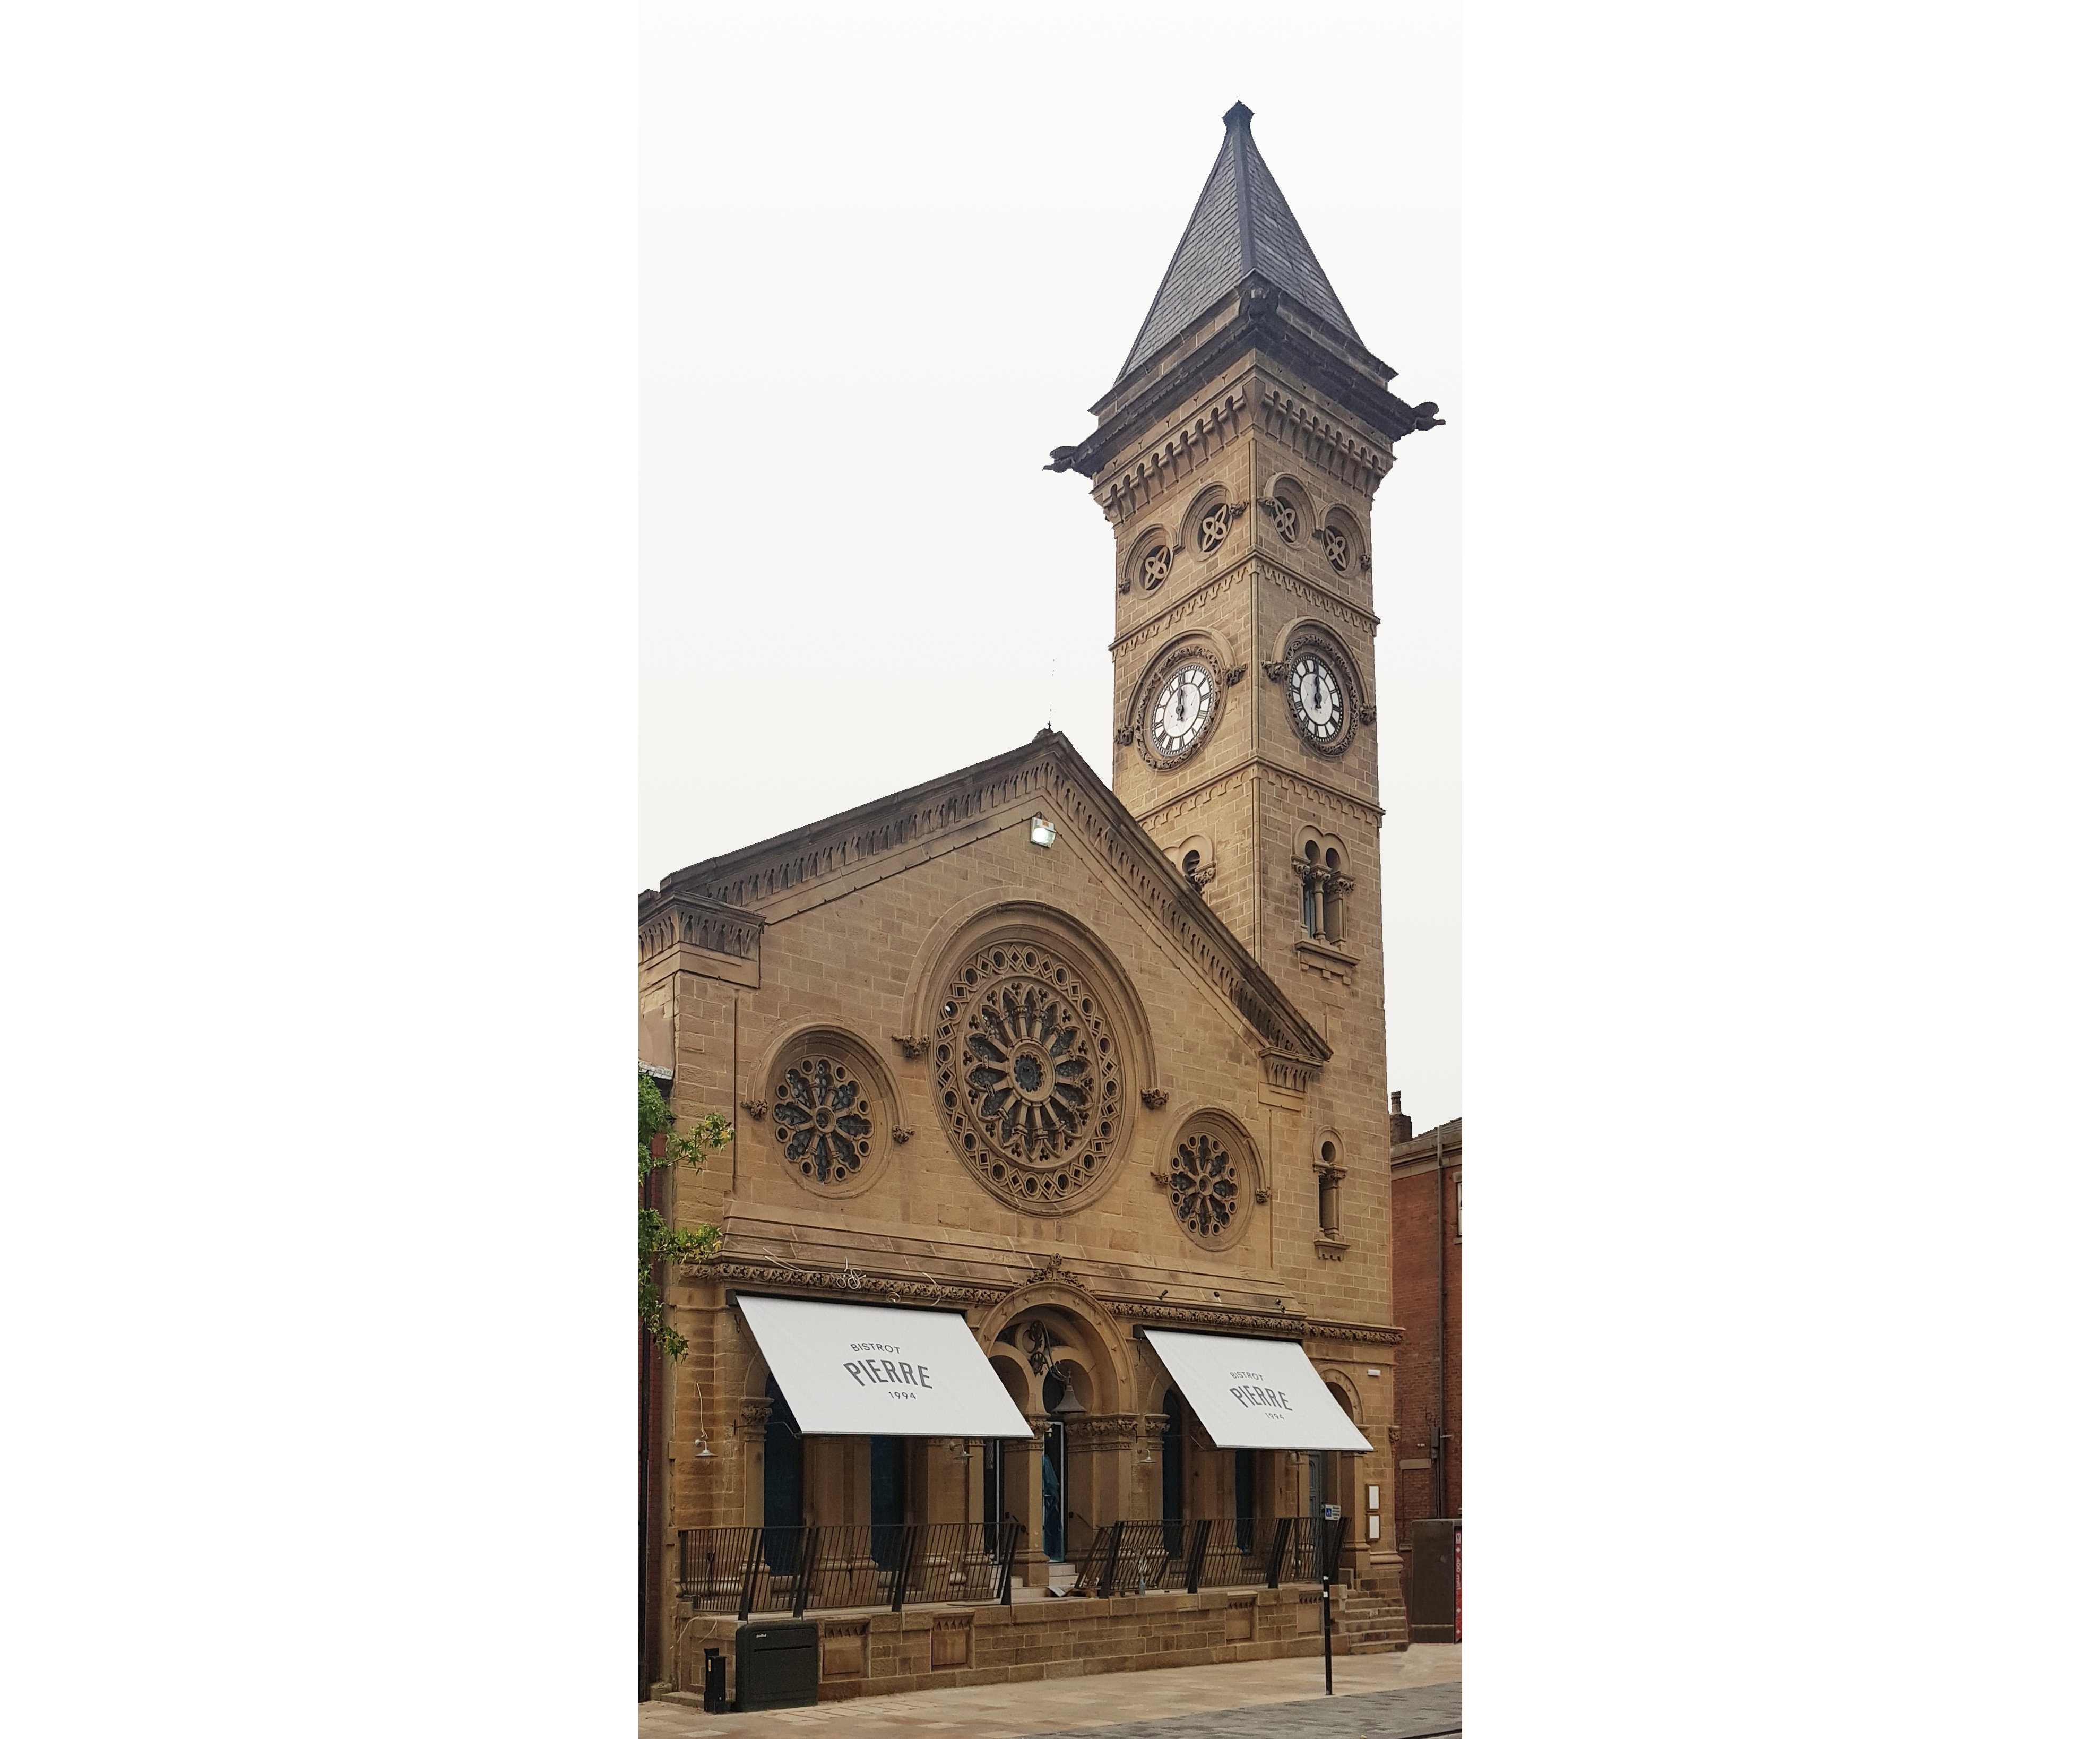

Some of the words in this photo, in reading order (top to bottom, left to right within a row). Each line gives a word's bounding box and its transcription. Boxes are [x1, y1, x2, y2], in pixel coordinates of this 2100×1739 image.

[850, 1343, 900, 1354] BISTROT
[843, 1359, 933, 1389] PIERRE
[1230, 1371, 1263, 1381] BISTROT
[888, 1391, 916, 1400] 1994
[1229, 1385, 1293, 1411] PIERRE
